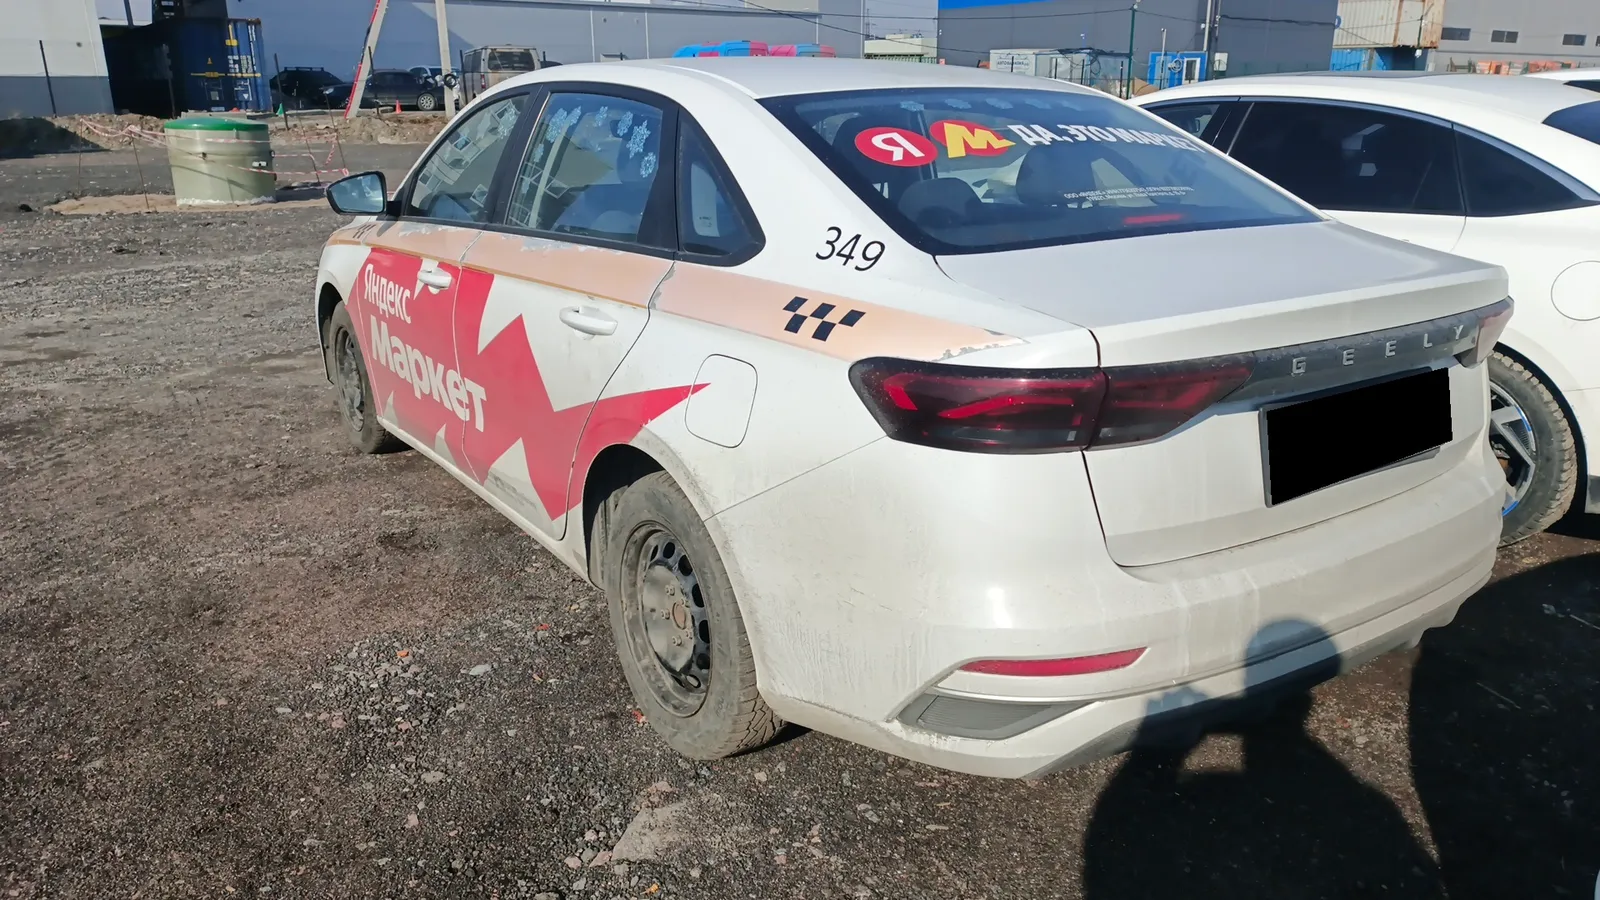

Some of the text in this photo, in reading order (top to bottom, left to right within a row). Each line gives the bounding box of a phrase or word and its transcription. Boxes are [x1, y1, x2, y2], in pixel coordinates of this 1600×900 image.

[871, 132, 925, 161] Я
[1007, 124, 1074, 146] ДА,
[1056, 124, 1118, 142] ЭТО
[815, 226, 886, 272] 349
[364, 264, 412, 324] Яндекс
[370, 316, 487, 433] Маркет
[1291, 325, 1464, 377] GEELY
